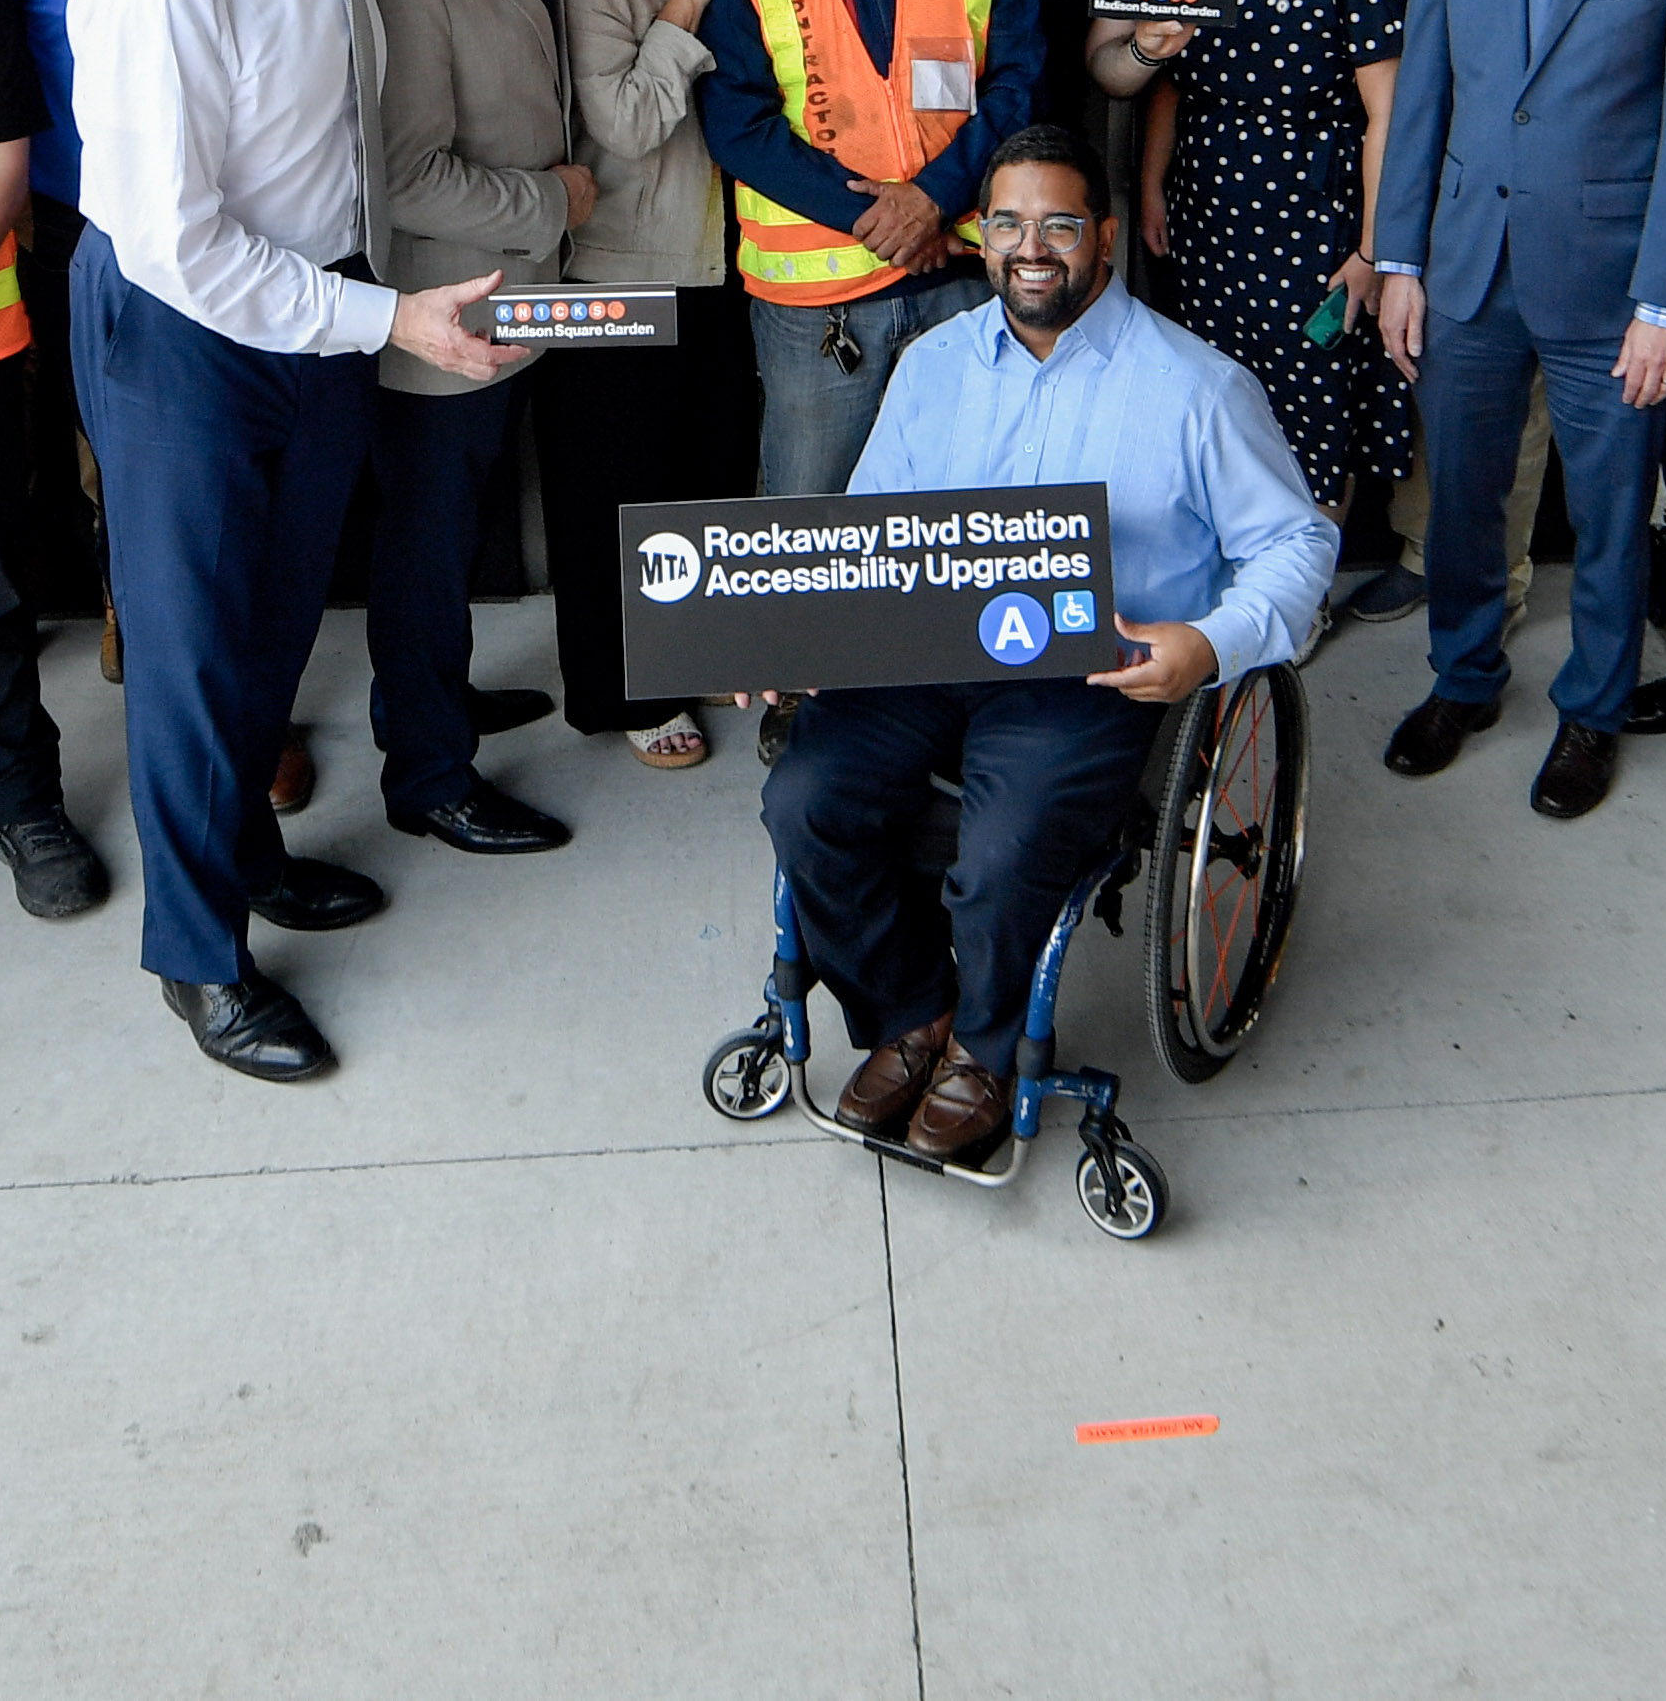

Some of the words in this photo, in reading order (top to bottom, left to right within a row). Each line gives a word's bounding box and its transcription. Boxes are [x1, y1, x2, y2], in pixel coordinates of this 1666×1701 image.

[1140, 2, 1179, 16] Square
[1180, 5, 1221, 18] Garden
[495, 324, 554, 339] Madison
[554, 323, 603, 339] Square
[604, 322, 655, 337] Garden
[703, 522, 880, 559] Rockaway
[885, 514, 961, 550] Blvd
[966, 508, 1091, 546] Station
[704, 556, 921, 598] Accessibility
[924, 548, 1092, 591] Upgrades
[994, 605, 1035, 651] A
